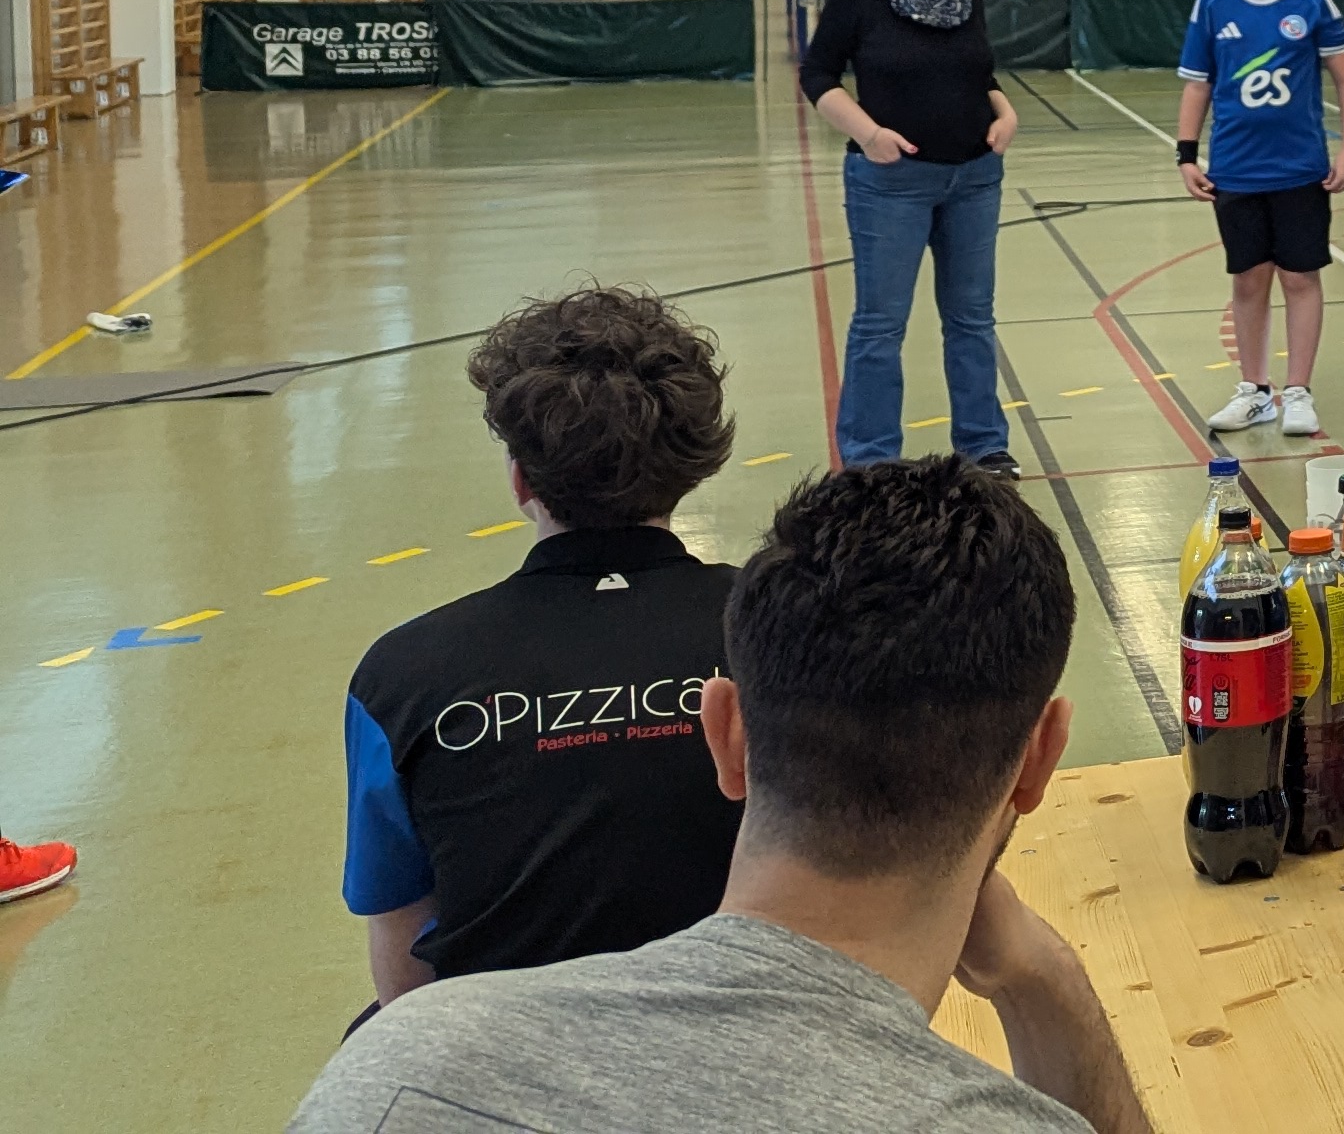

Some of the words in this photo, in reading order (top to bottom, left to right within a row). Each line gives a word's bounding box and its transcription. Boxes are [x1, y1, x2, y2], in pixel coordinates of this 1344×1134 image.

[253, 23, 344, 46] Garage
[325, 49, 350, 61] 03
[356, 48, 381, 60] 88
[388, 48, 413, 60] 56
[536, 730, 608, 752] Pasteria
[626, 721, 694, 740] Pizzeria
